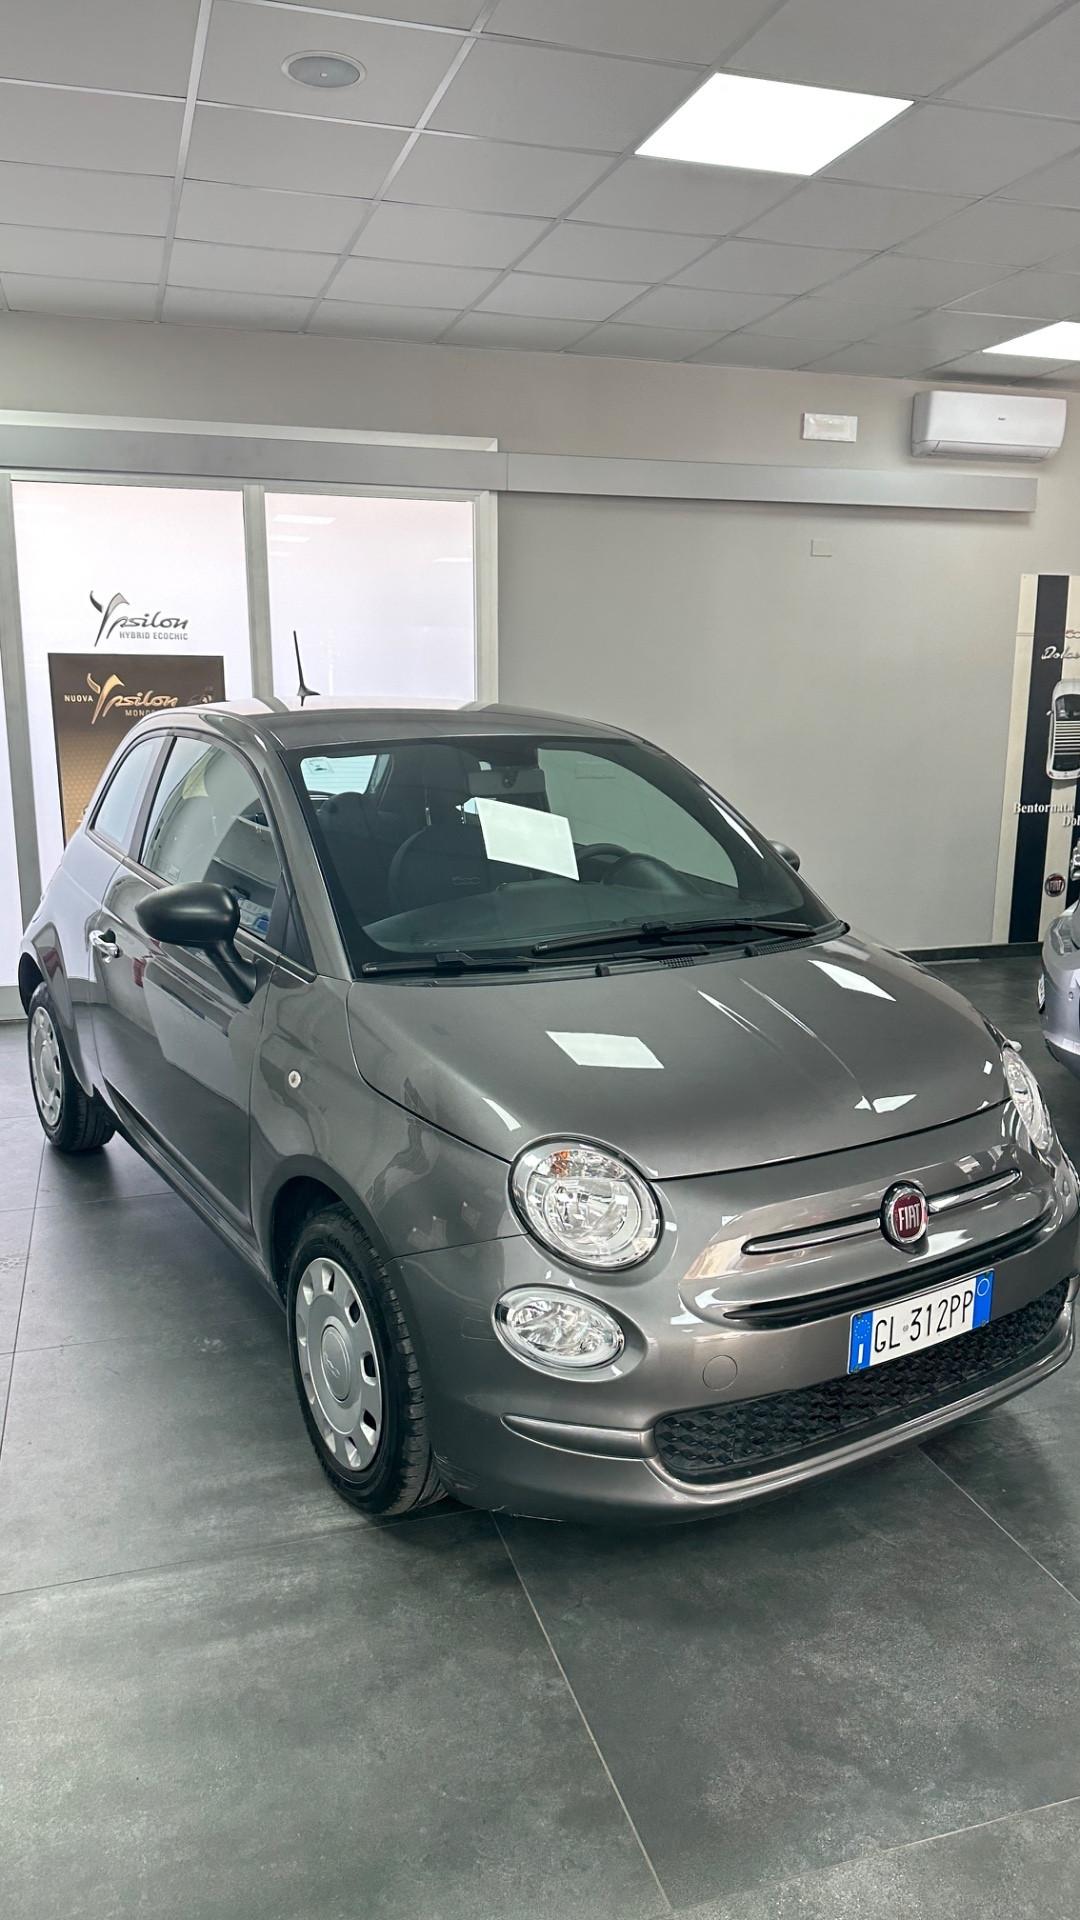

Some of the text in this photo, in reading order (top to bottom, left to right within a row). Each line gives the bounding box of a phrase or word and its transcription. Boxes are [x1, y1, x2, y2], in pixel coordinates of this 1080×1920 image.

[89, 590, 188, 647] Ypsilon
[119, 631, 188, 641] HYBRID ECOCHIC
[64, 672, 178, 725] NUOVA Ypsilon
[897, 1202, 921, 1231] FIAT
